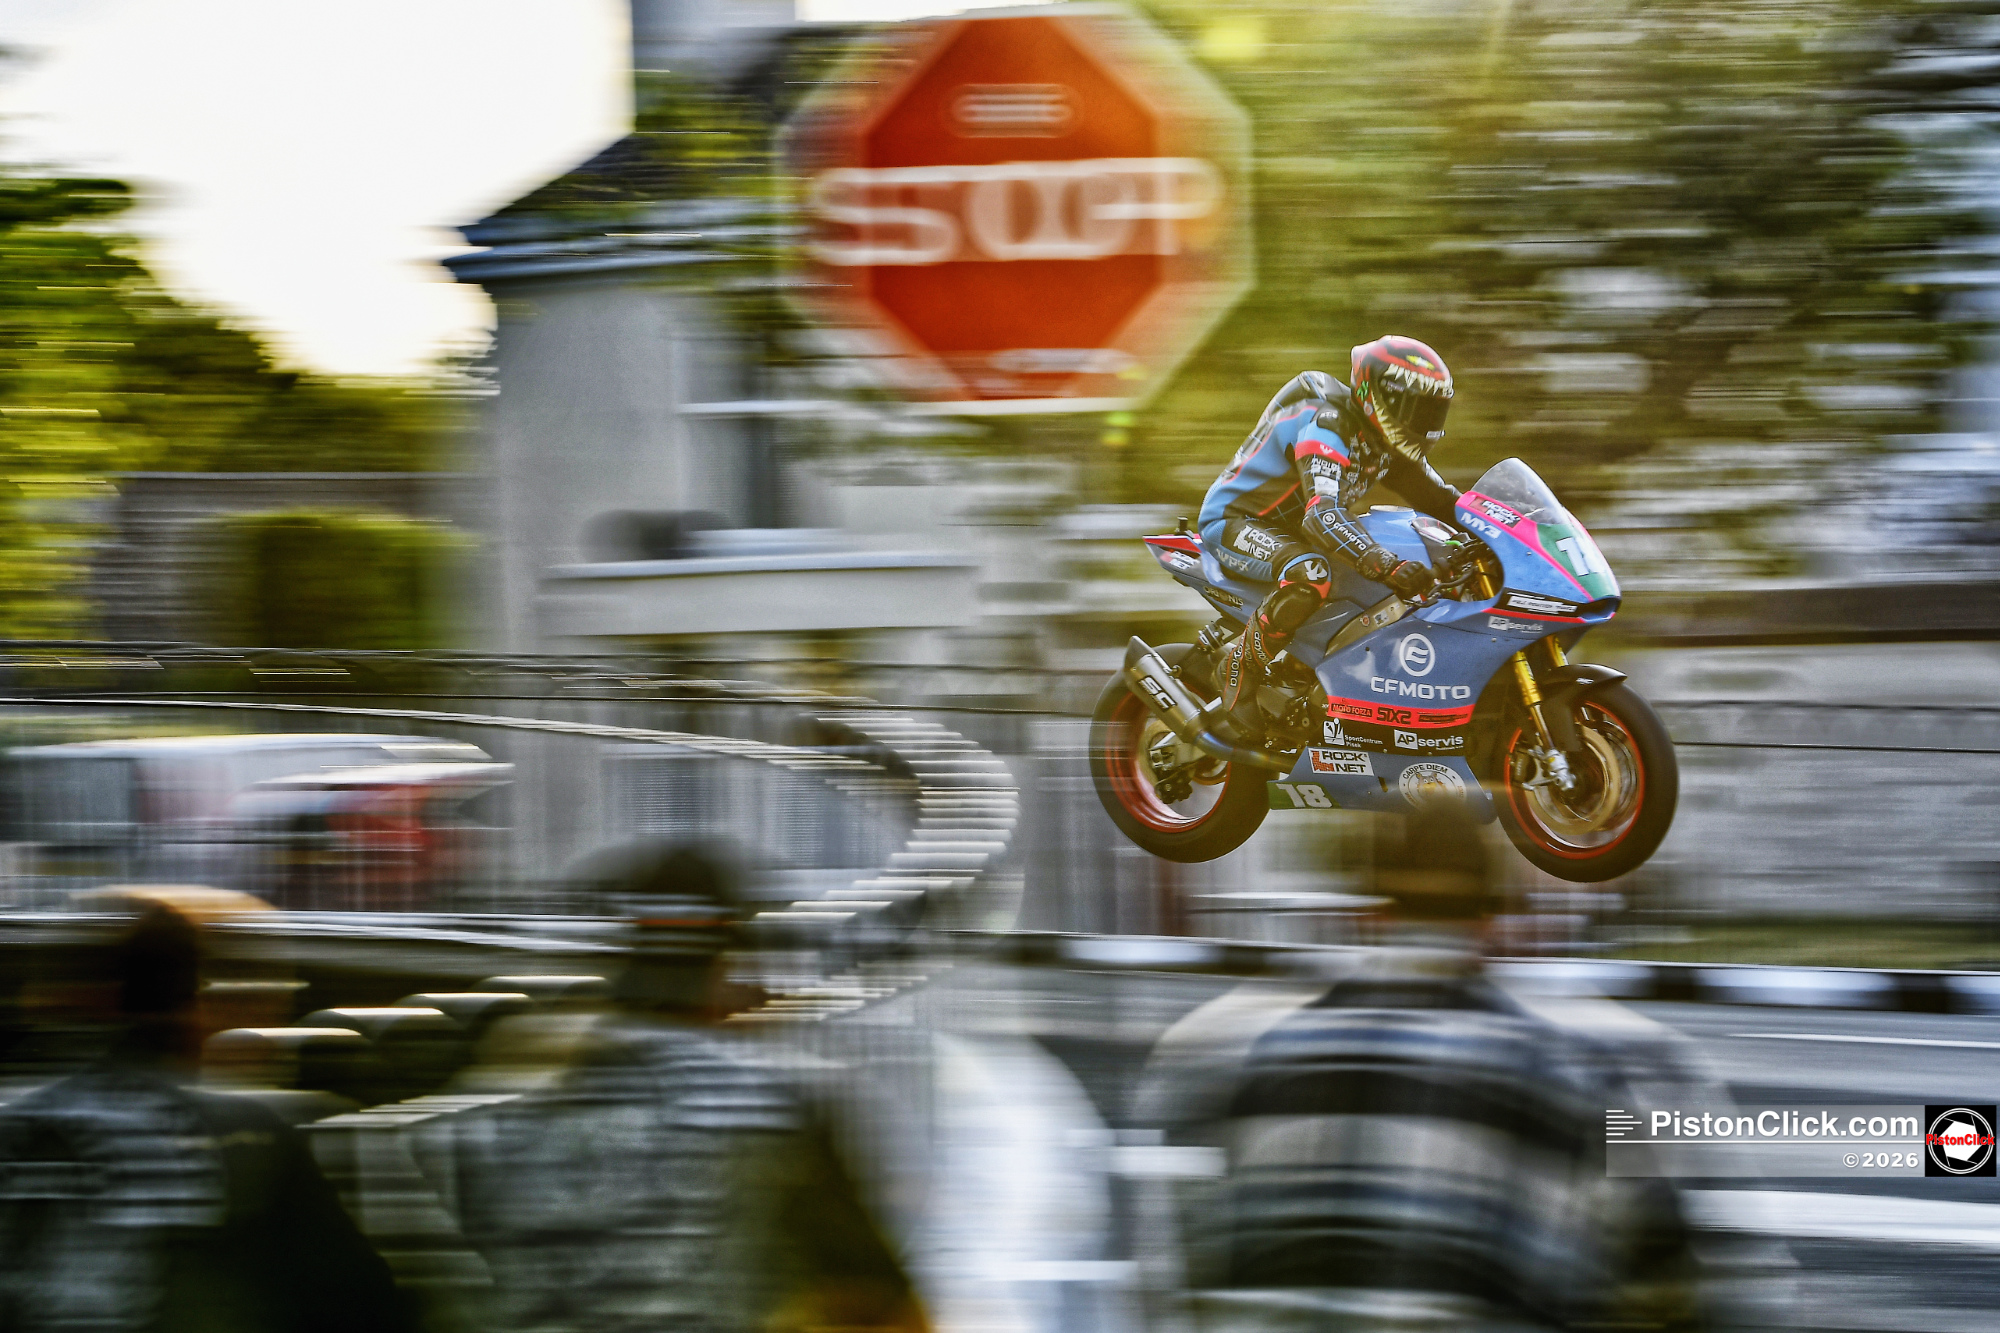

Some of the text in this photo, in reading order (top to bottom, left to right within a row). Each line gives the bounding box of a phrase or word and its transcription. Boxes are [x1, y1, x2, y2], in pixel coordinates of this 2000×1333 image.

[1248, 528, 1280, 551] ROCK
[1333, 522, 1367, 551] CFMOTO
[1250, 542, 1273, 561] NET
[1139, 676, 1176, 709] SC
[1370, 676, 1471, 700] CFMOTO
[1332, 703, 1351, 715] MOTO
[1376, 706, 1412, 725] SIX2
[1396, 732, 1464, 747] AP servis
[1321, 750, 1366, 762] ROCK
[1335, 763, 1366, 773] NET
[1402, 763, 1449, 780] CARPE DIEM
[1276, 783, 1333, 808] 18
